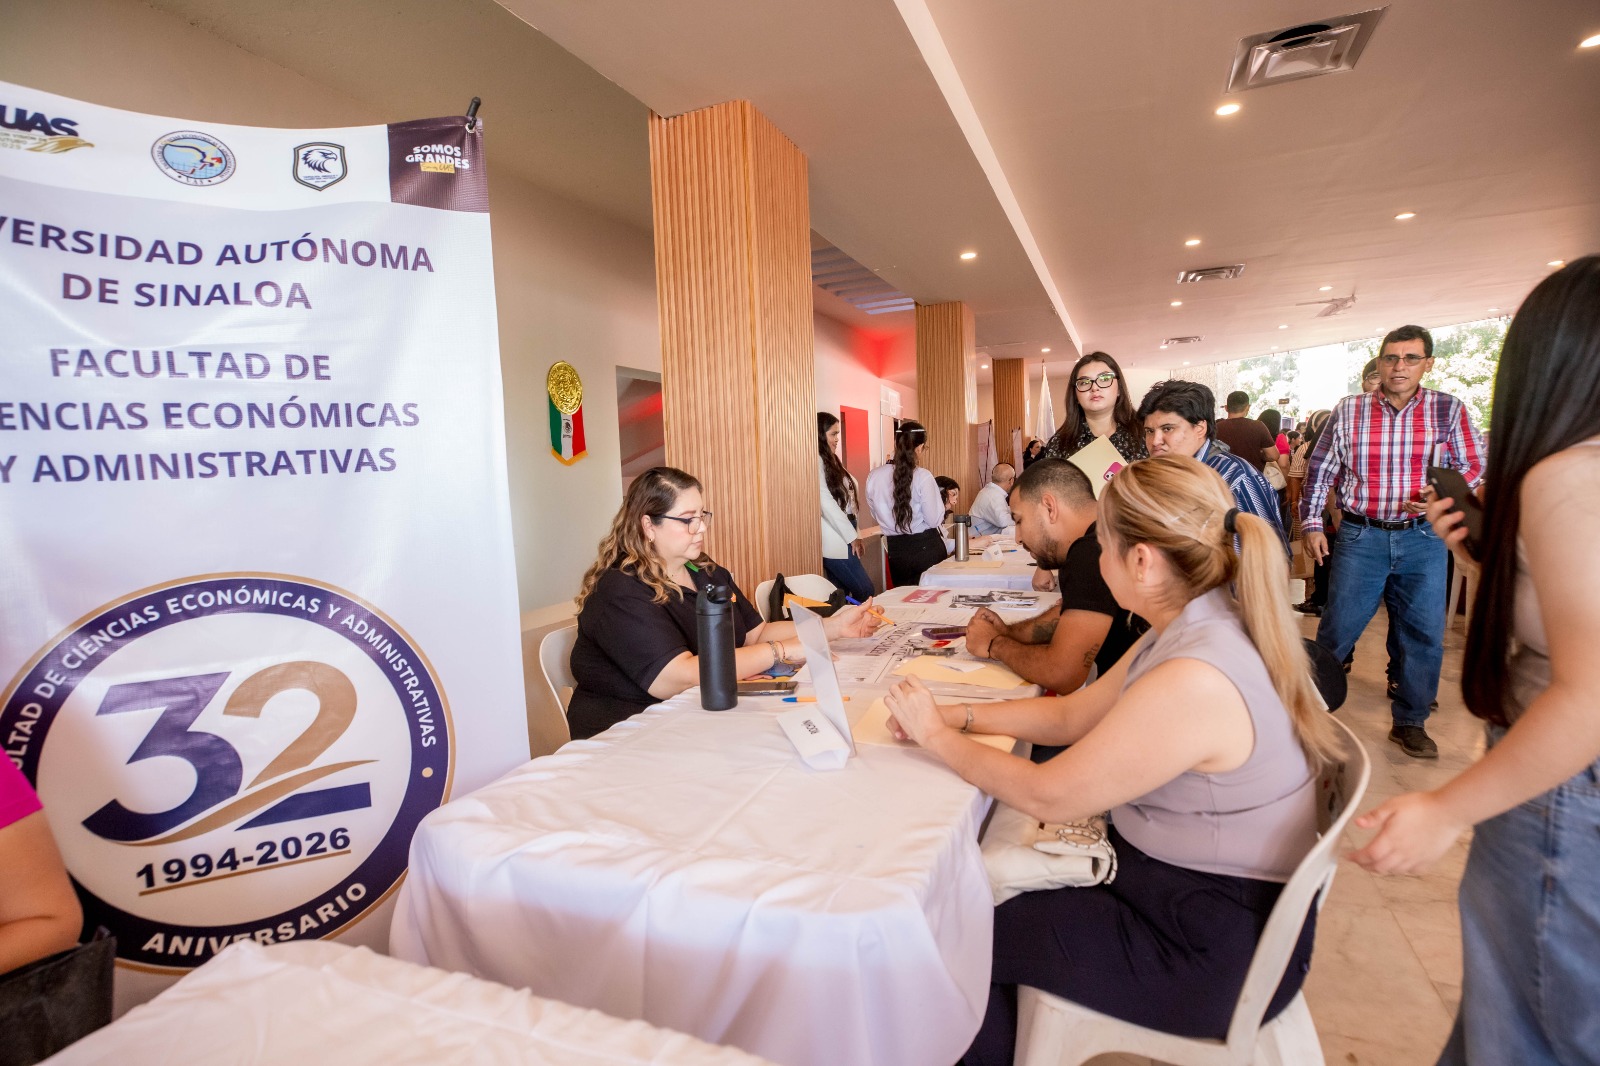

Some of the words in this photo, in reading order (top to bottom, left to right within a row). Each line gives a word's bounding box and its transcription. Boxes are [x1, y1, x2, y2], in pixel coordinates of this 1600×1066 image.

[0, 105, 79, 137] UAS
[405, 153, 469, 169] GRANDES
[413, 144, 461, 157] SOMOS
[216, 233, 434, 273] AUTÓNOMA
[62, 273, 119, 304] DE
[134, 281, 313, 309] SINALOA
[49, 348, 271, 380] FACULTAD
[285, 354, 331, 381] DE
[0, 402, 148, 430] ENCIAS
[163, 396, 420, 429] ECONÓMICAS
[0, 455, 17, 483] Y
[32, 447, 397, 482] ADMINISTRATIVAS
[33, 669, 67, 698] DE
[62, 605, 160, 669] CIENCIAS
[166, 585, 321, 614] ECONÓMICAS
[327, 603, 340, 619] Y
[341, 614, 436, 747] ADMINISTRATIVAS
[82, 661, 380, 846] 32
[136, 827, 351, 889] 1994-2026
